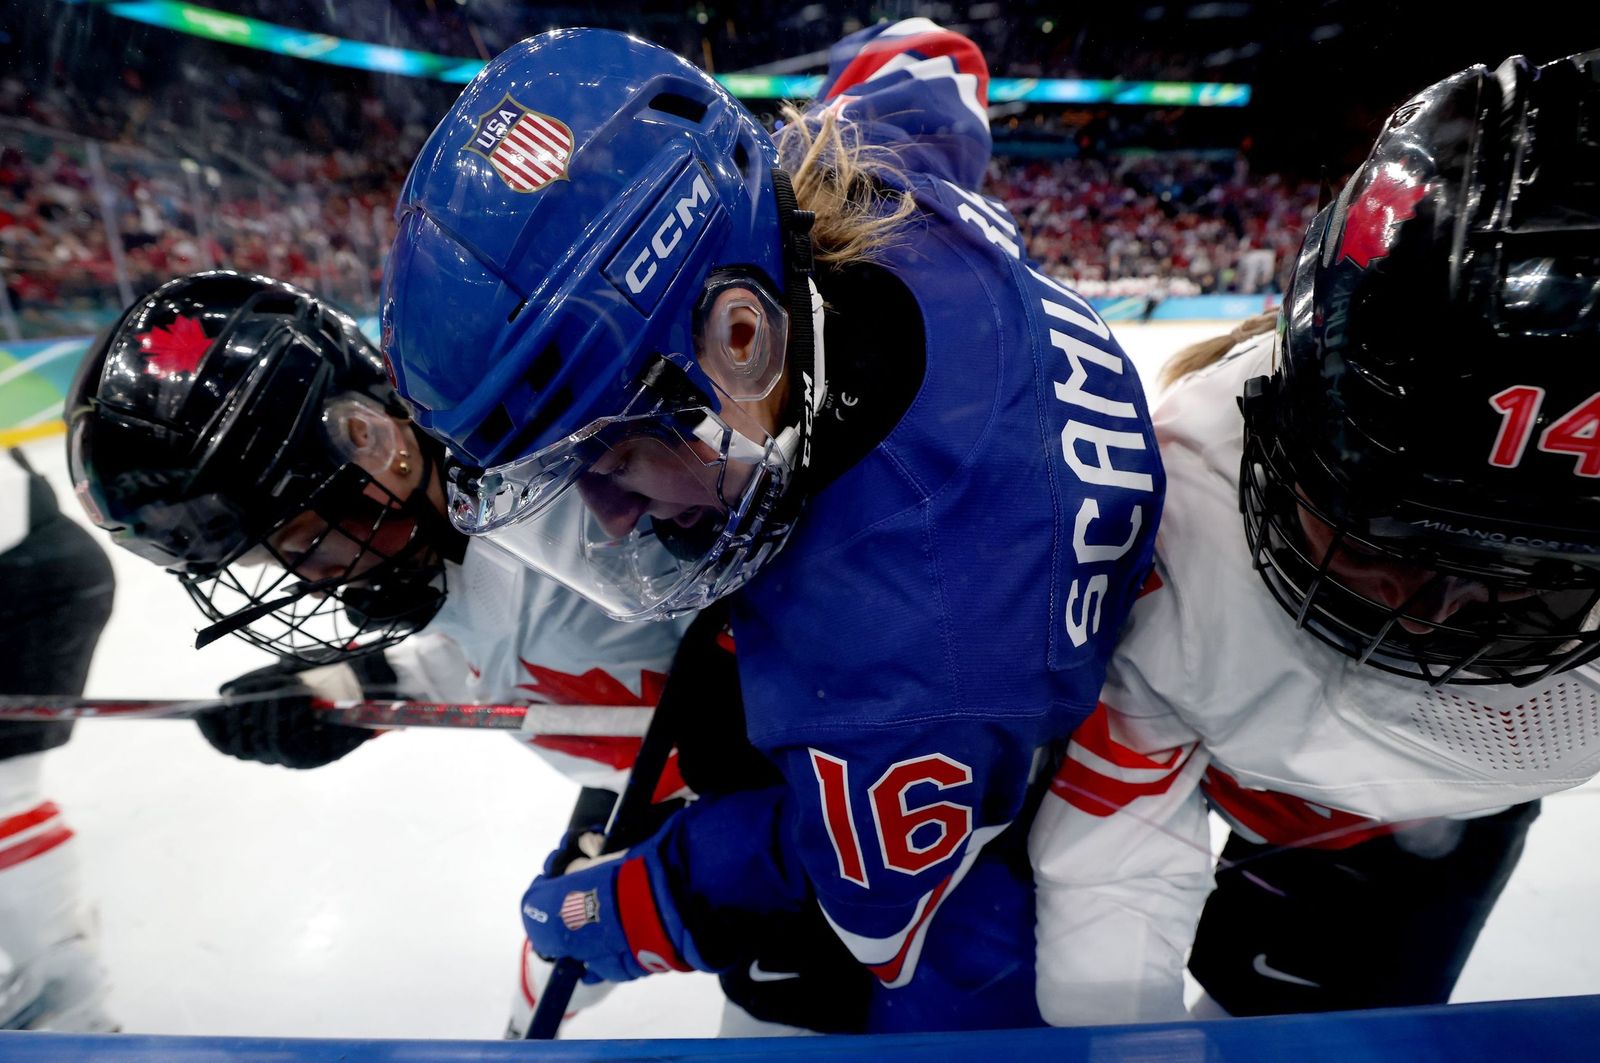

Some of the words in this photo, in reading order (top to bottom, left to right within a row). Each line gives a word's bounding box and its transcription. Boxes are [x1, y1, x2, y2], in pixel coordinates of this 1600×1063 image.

[476, 108, 518, 149] USA
[624, 174, 712, 294] CCM
[801, 371, 813, 468] CCM
[1488, 384, 1600, 478] 14
[1410, 519, 1507, 543] MILANO
[807, 747, 973, 889] 16
